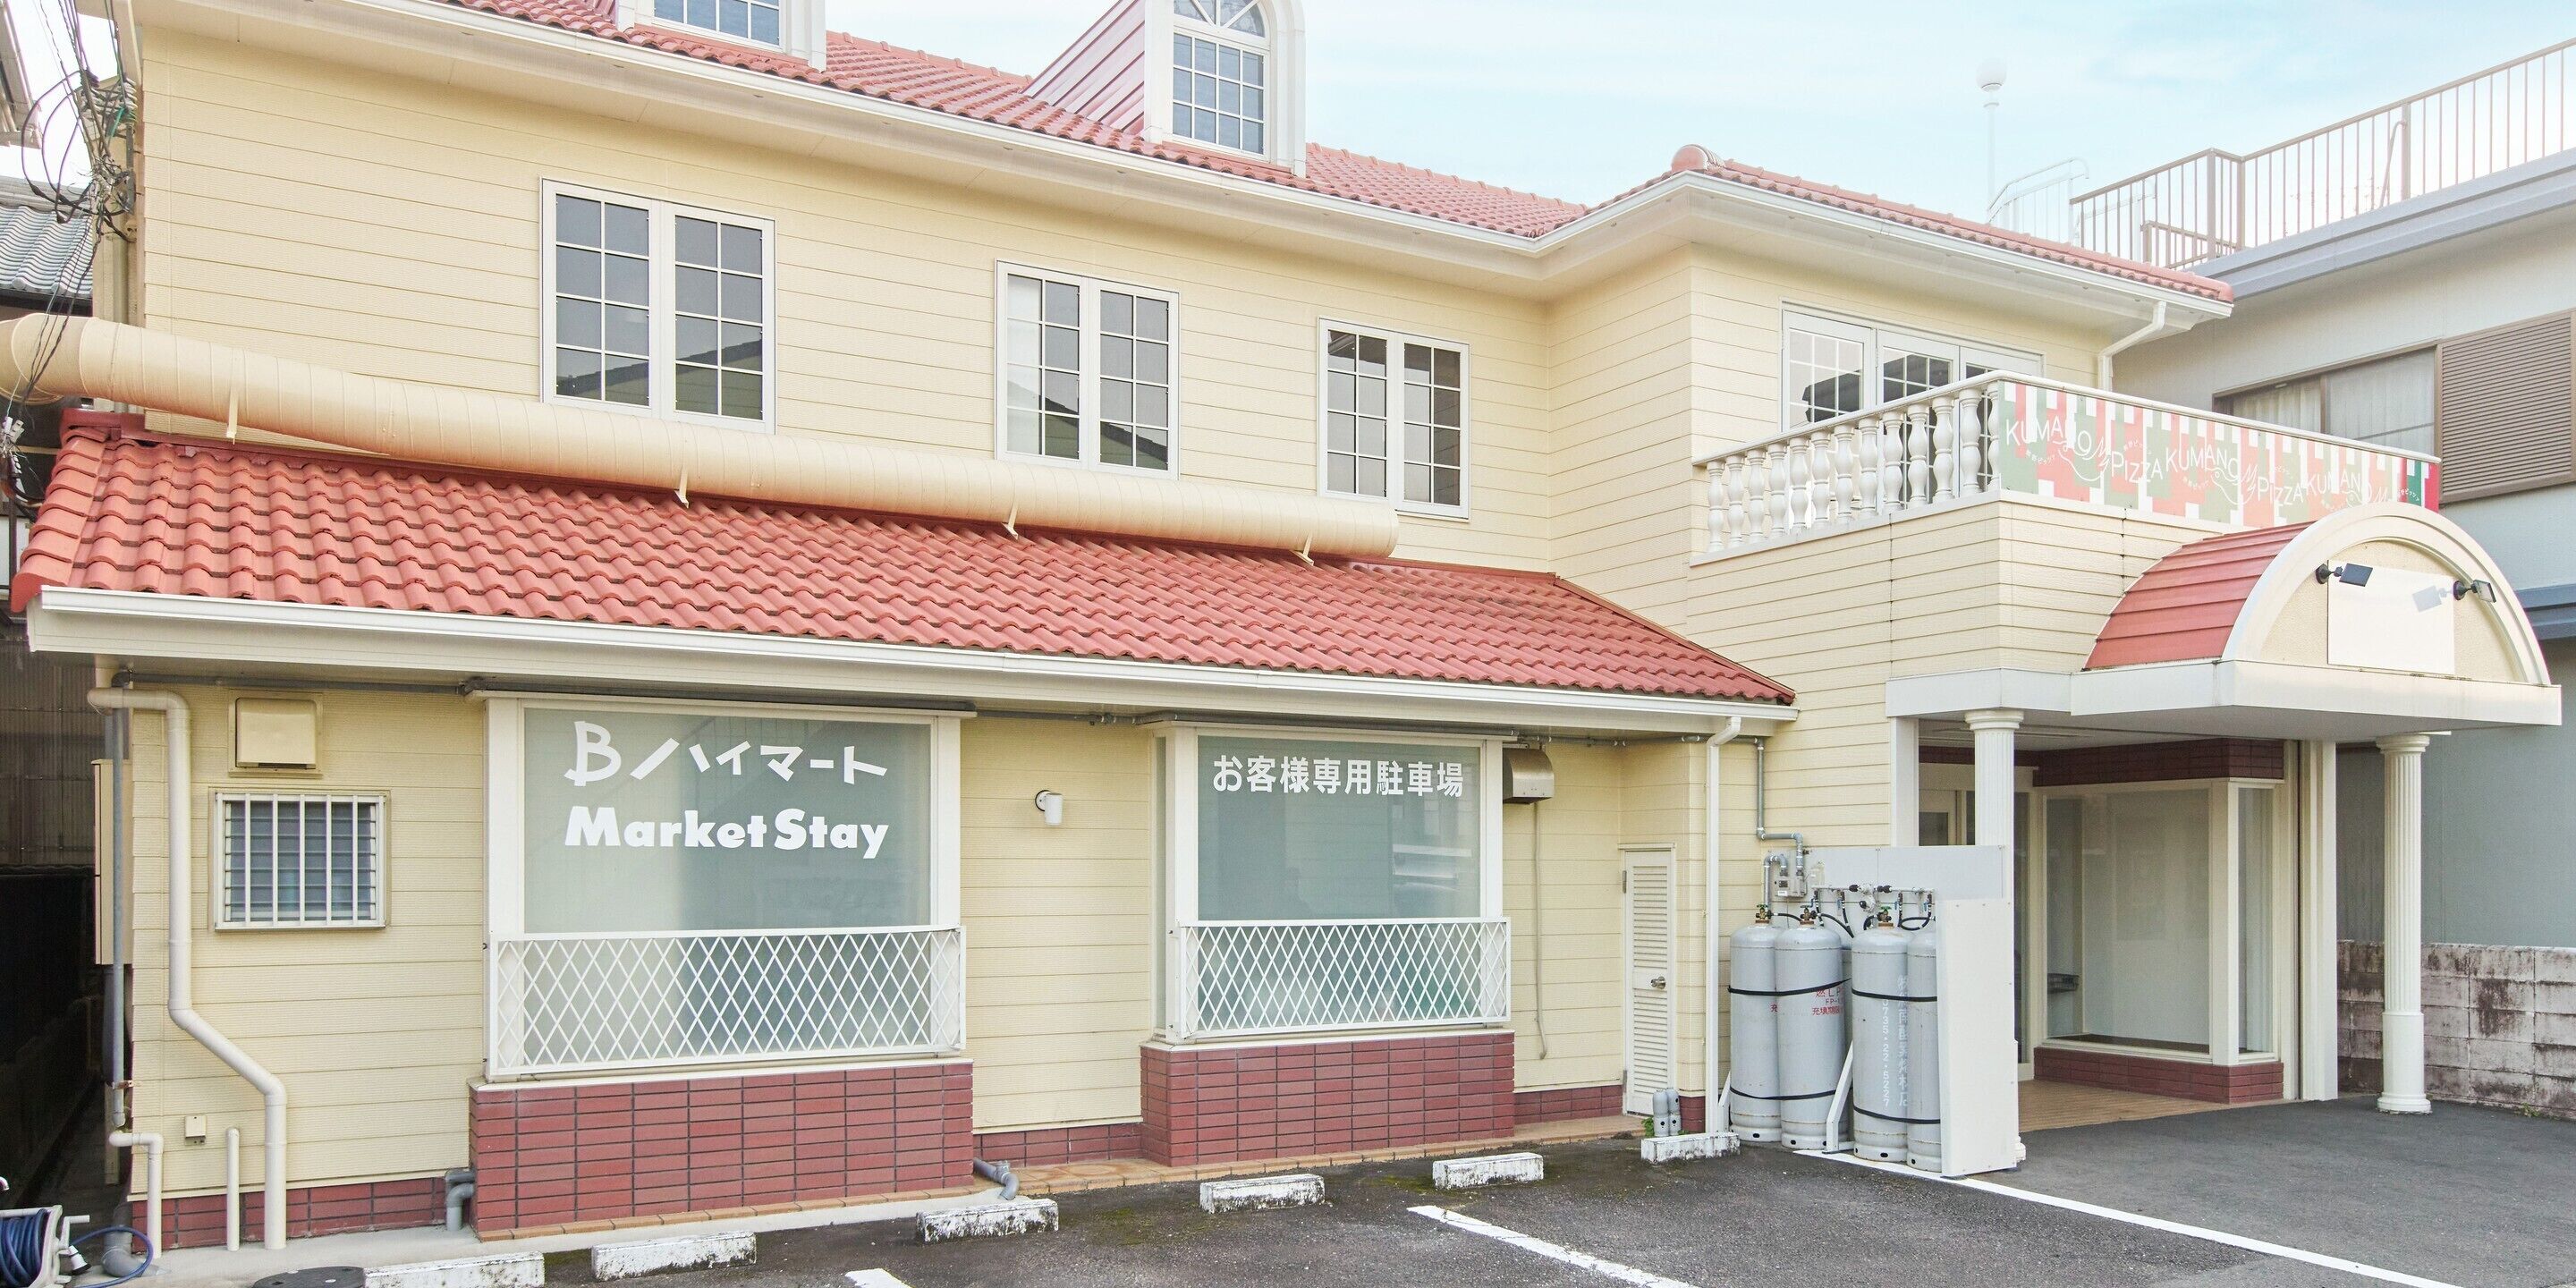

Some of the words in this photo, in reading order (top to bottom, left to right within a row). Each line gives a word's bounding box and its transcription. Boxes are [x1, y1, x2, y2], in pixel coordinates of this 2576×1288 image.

[2006, 415, 2092, 453] KUMAO
[2111, 450, 2164, 484] PIZZA
[2165, 444, 2239, 479] KUMANO
[2257, 476, 2304, 507] PIZZA
[1213, 754, 1464, 798] お客様専用駐車場
